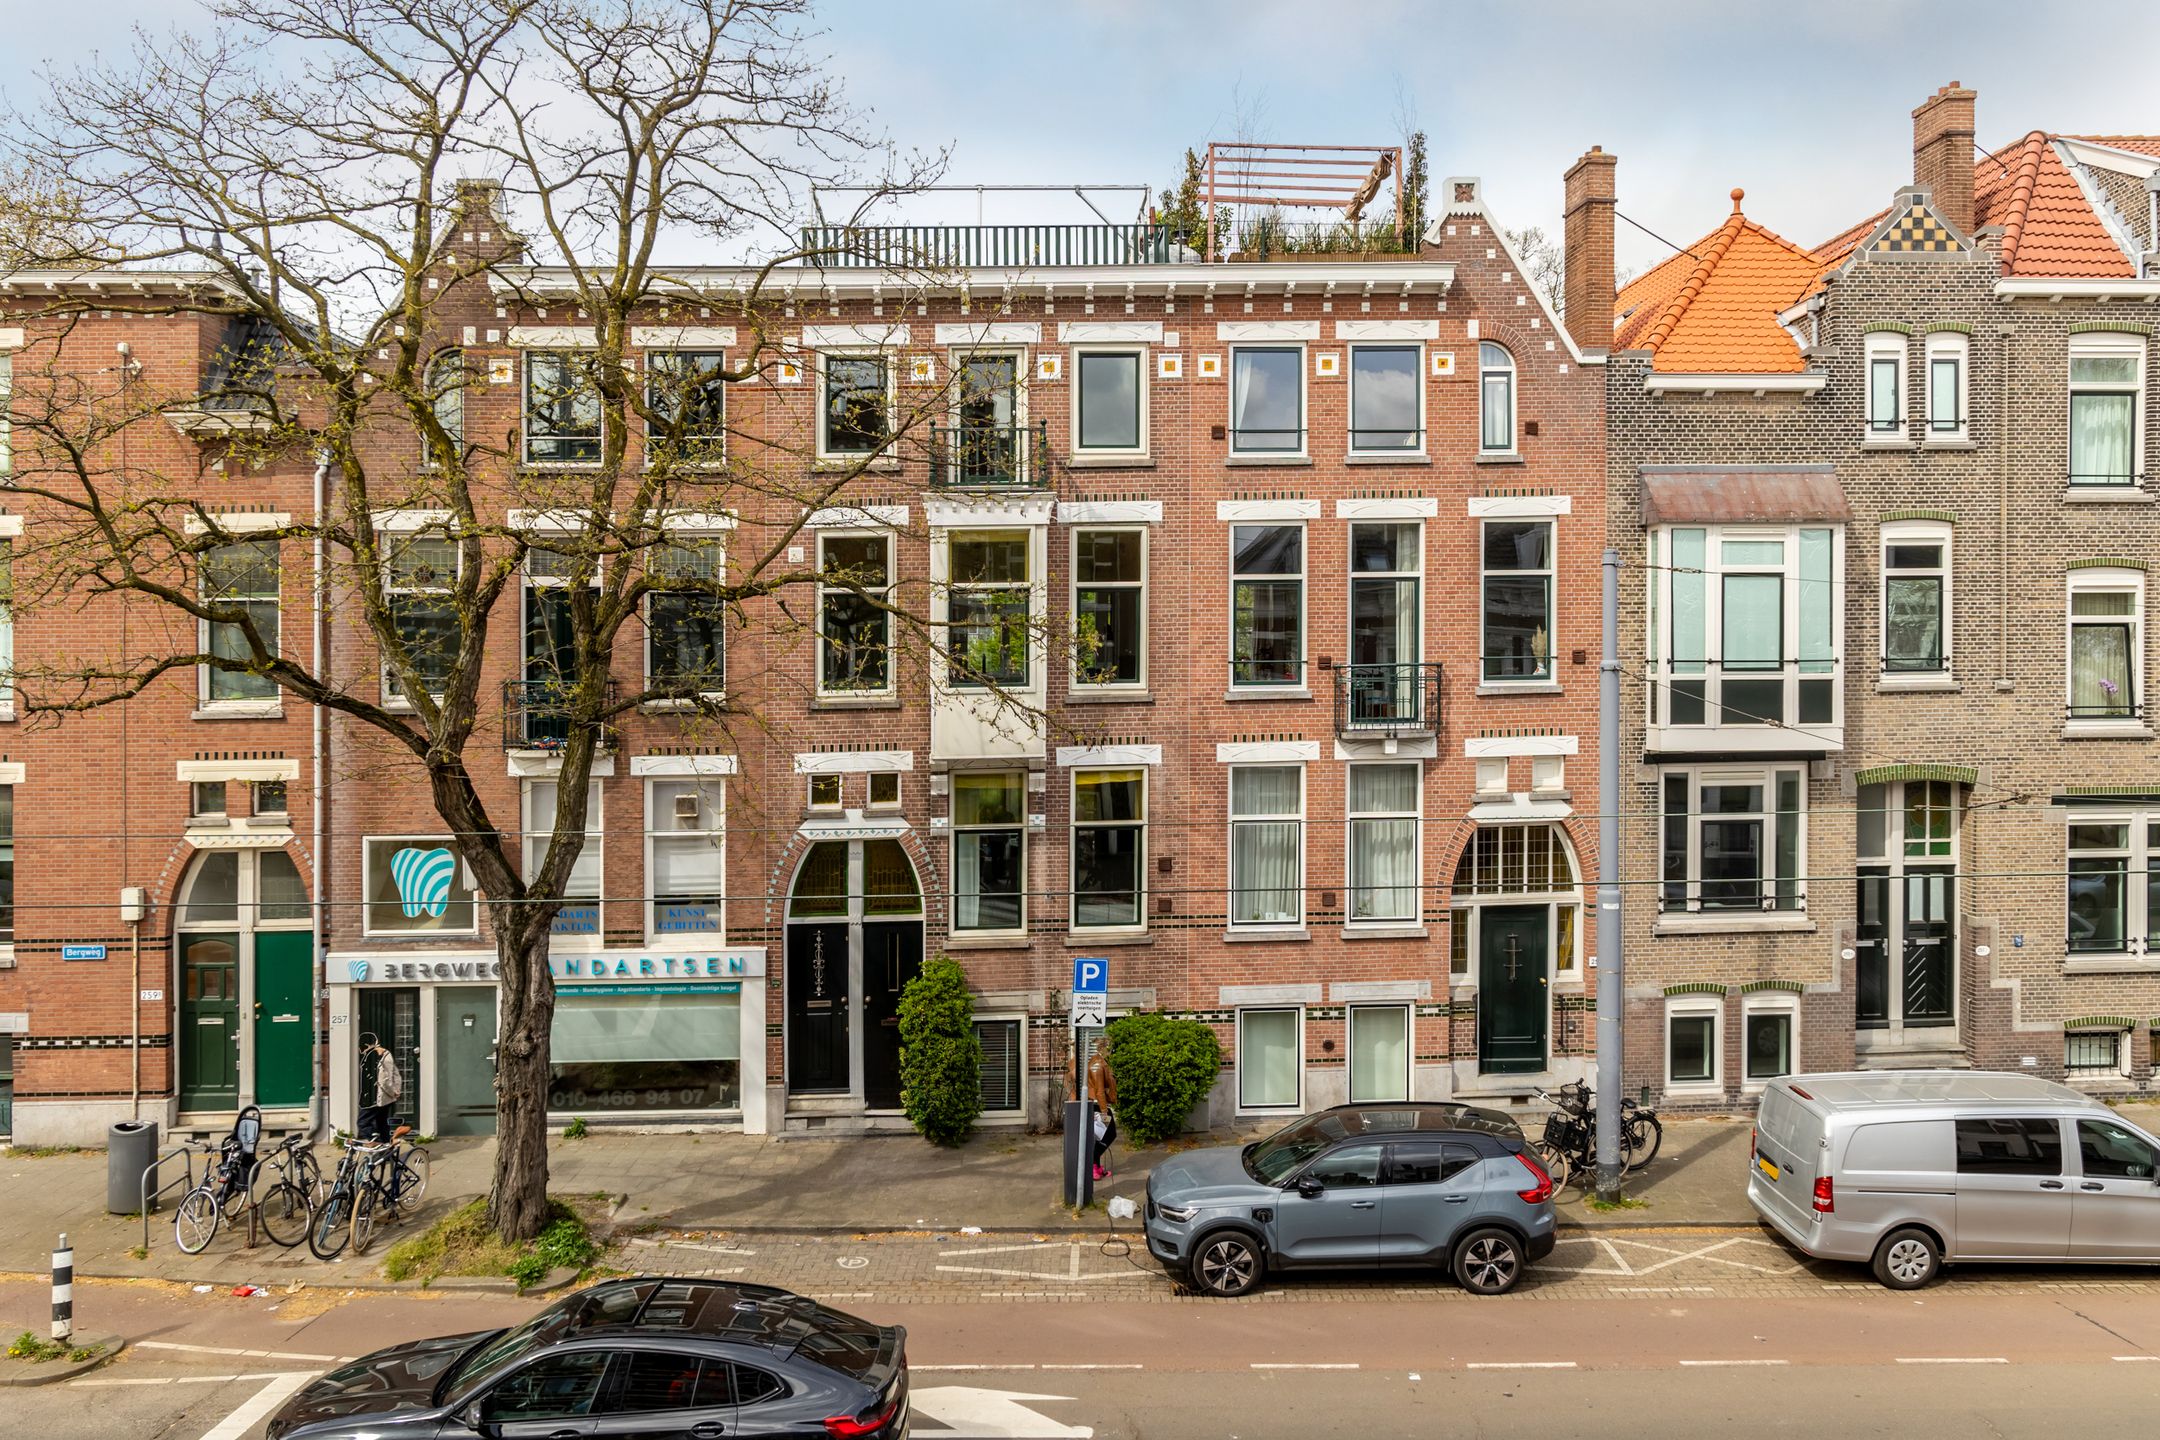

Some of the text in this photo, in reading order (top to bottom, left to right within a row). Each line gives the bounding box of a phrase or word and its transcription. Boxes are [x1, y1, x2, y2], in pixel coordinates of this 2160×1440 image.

[559, 910, 598, 919] DARTS
[668, 908, 705, 917] KUNST
[552, 922, 597, 932] AKTIJK
[66, 949, 101, 958] Bergweg
[1081, 963, 1100, 988] P
[331, 1015, 348, 1024] 257
[645, 1089, 671, 1105] 94
[679, 1089, 705, 1105] 07
